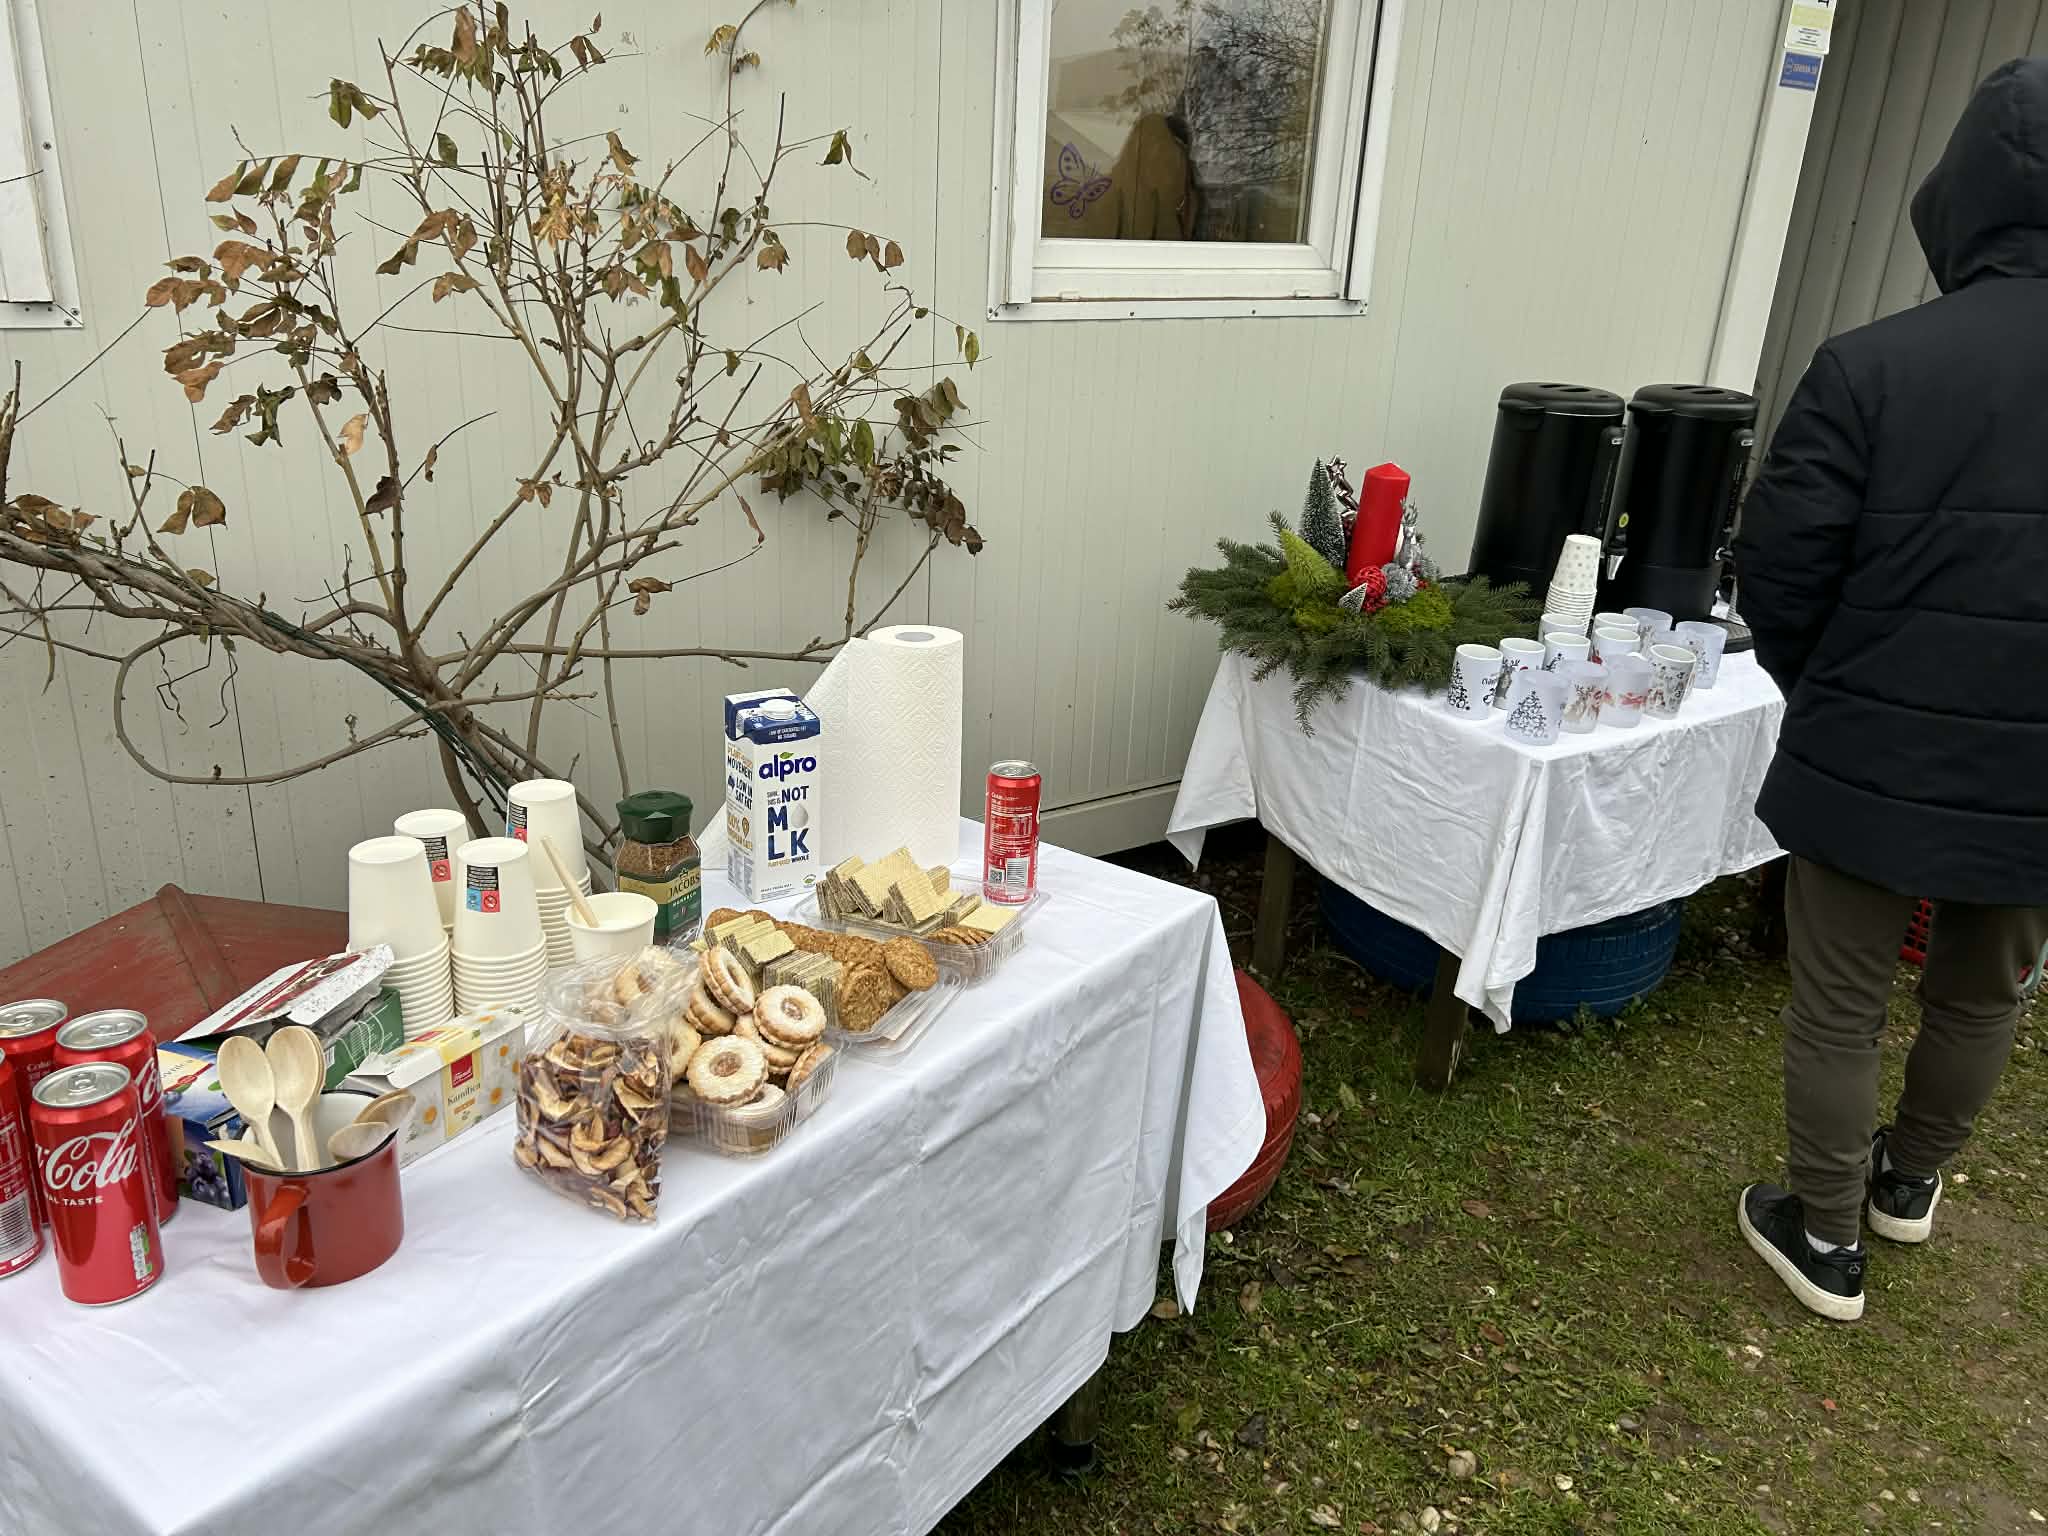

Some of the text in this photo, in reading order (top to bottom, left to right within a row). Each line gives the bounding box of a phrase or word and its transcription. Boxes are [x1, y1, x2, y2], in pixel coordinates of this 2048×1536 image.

[759, 754, 817, 782] alpro
[782, 785, 810, 803] NOT
[791, 853, 810, 864] WHOLE
[670, 873, 701, 897] JACOBS
[35, 1113, 139, 1192] -Cola
[63, 1195, 104, 1206] TASTE
